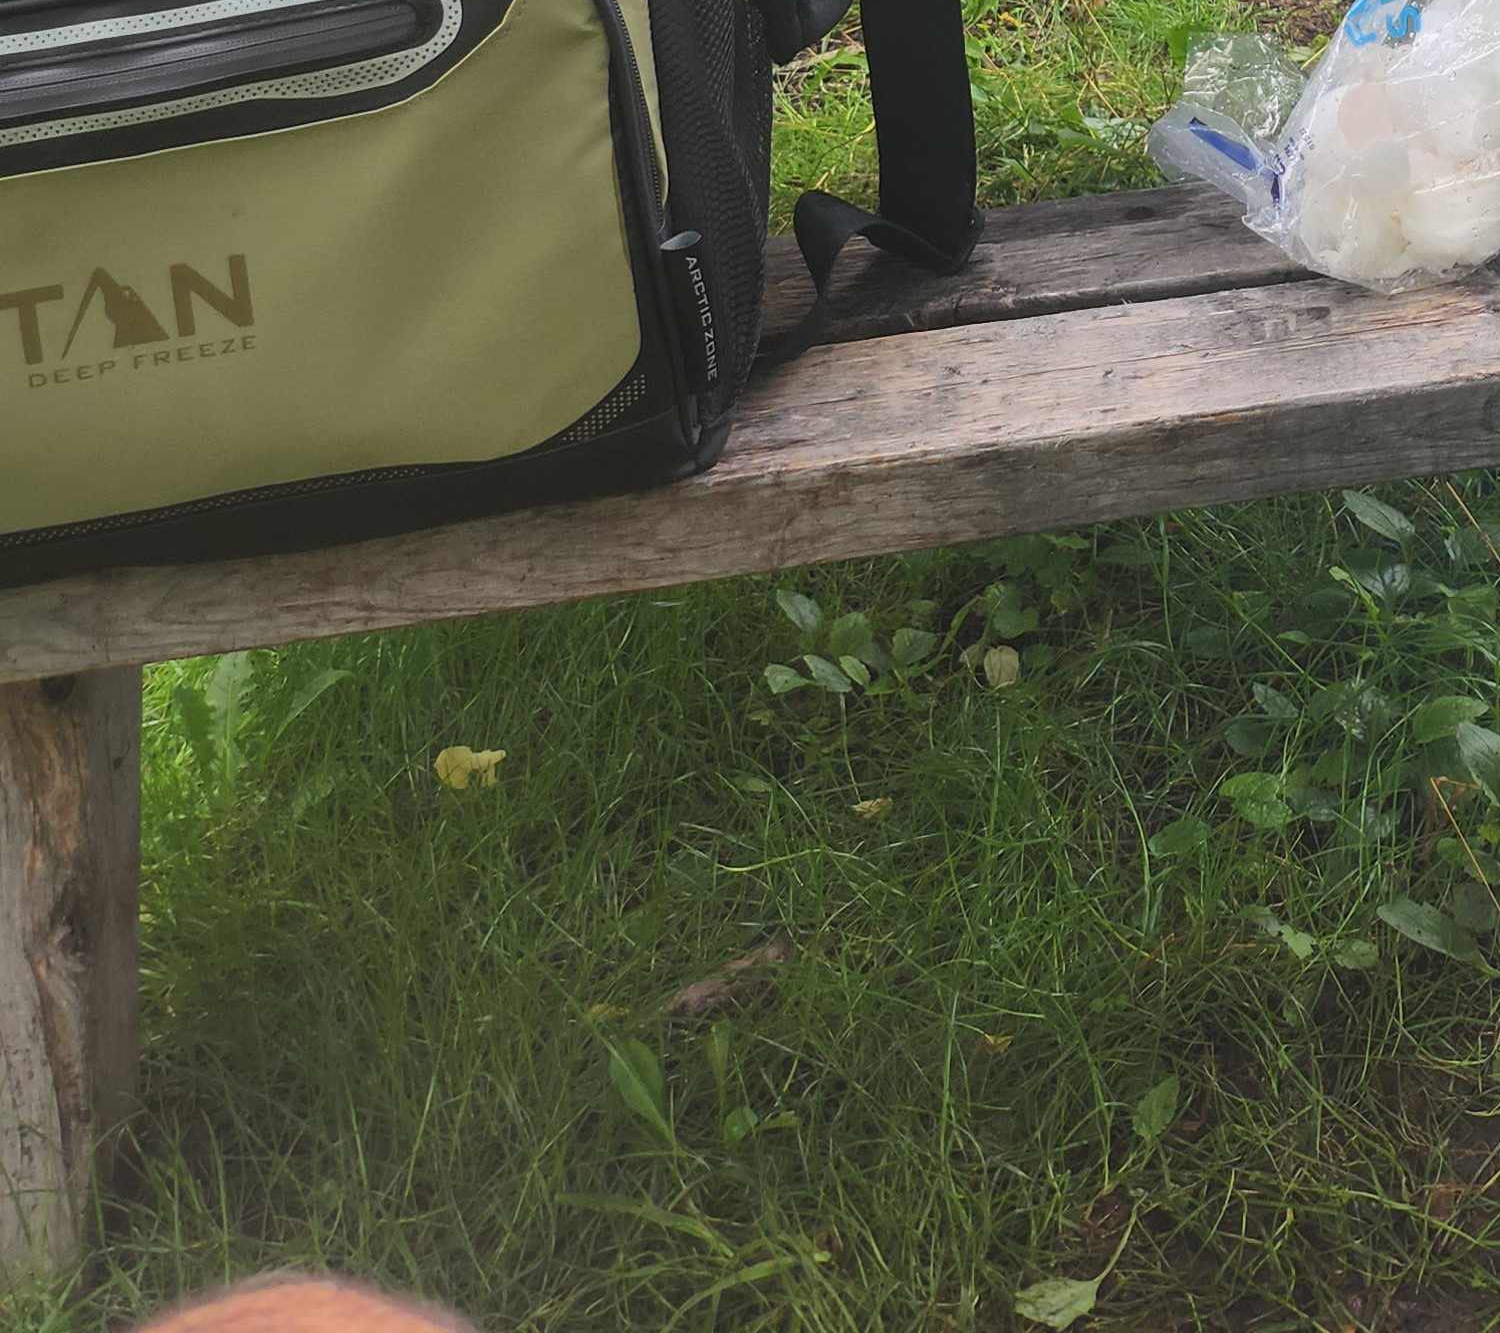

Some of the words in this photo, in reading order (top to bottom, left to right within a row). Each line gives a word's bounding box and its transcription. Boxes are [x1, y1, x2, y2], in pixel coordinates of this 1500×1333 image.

[27, 359, 117, 389] DEEP
[132, 334, 257, 370] FREEZE
[685, 256, 712, 327] ARCTIC
[704, 327, 718, 382] ZONE
